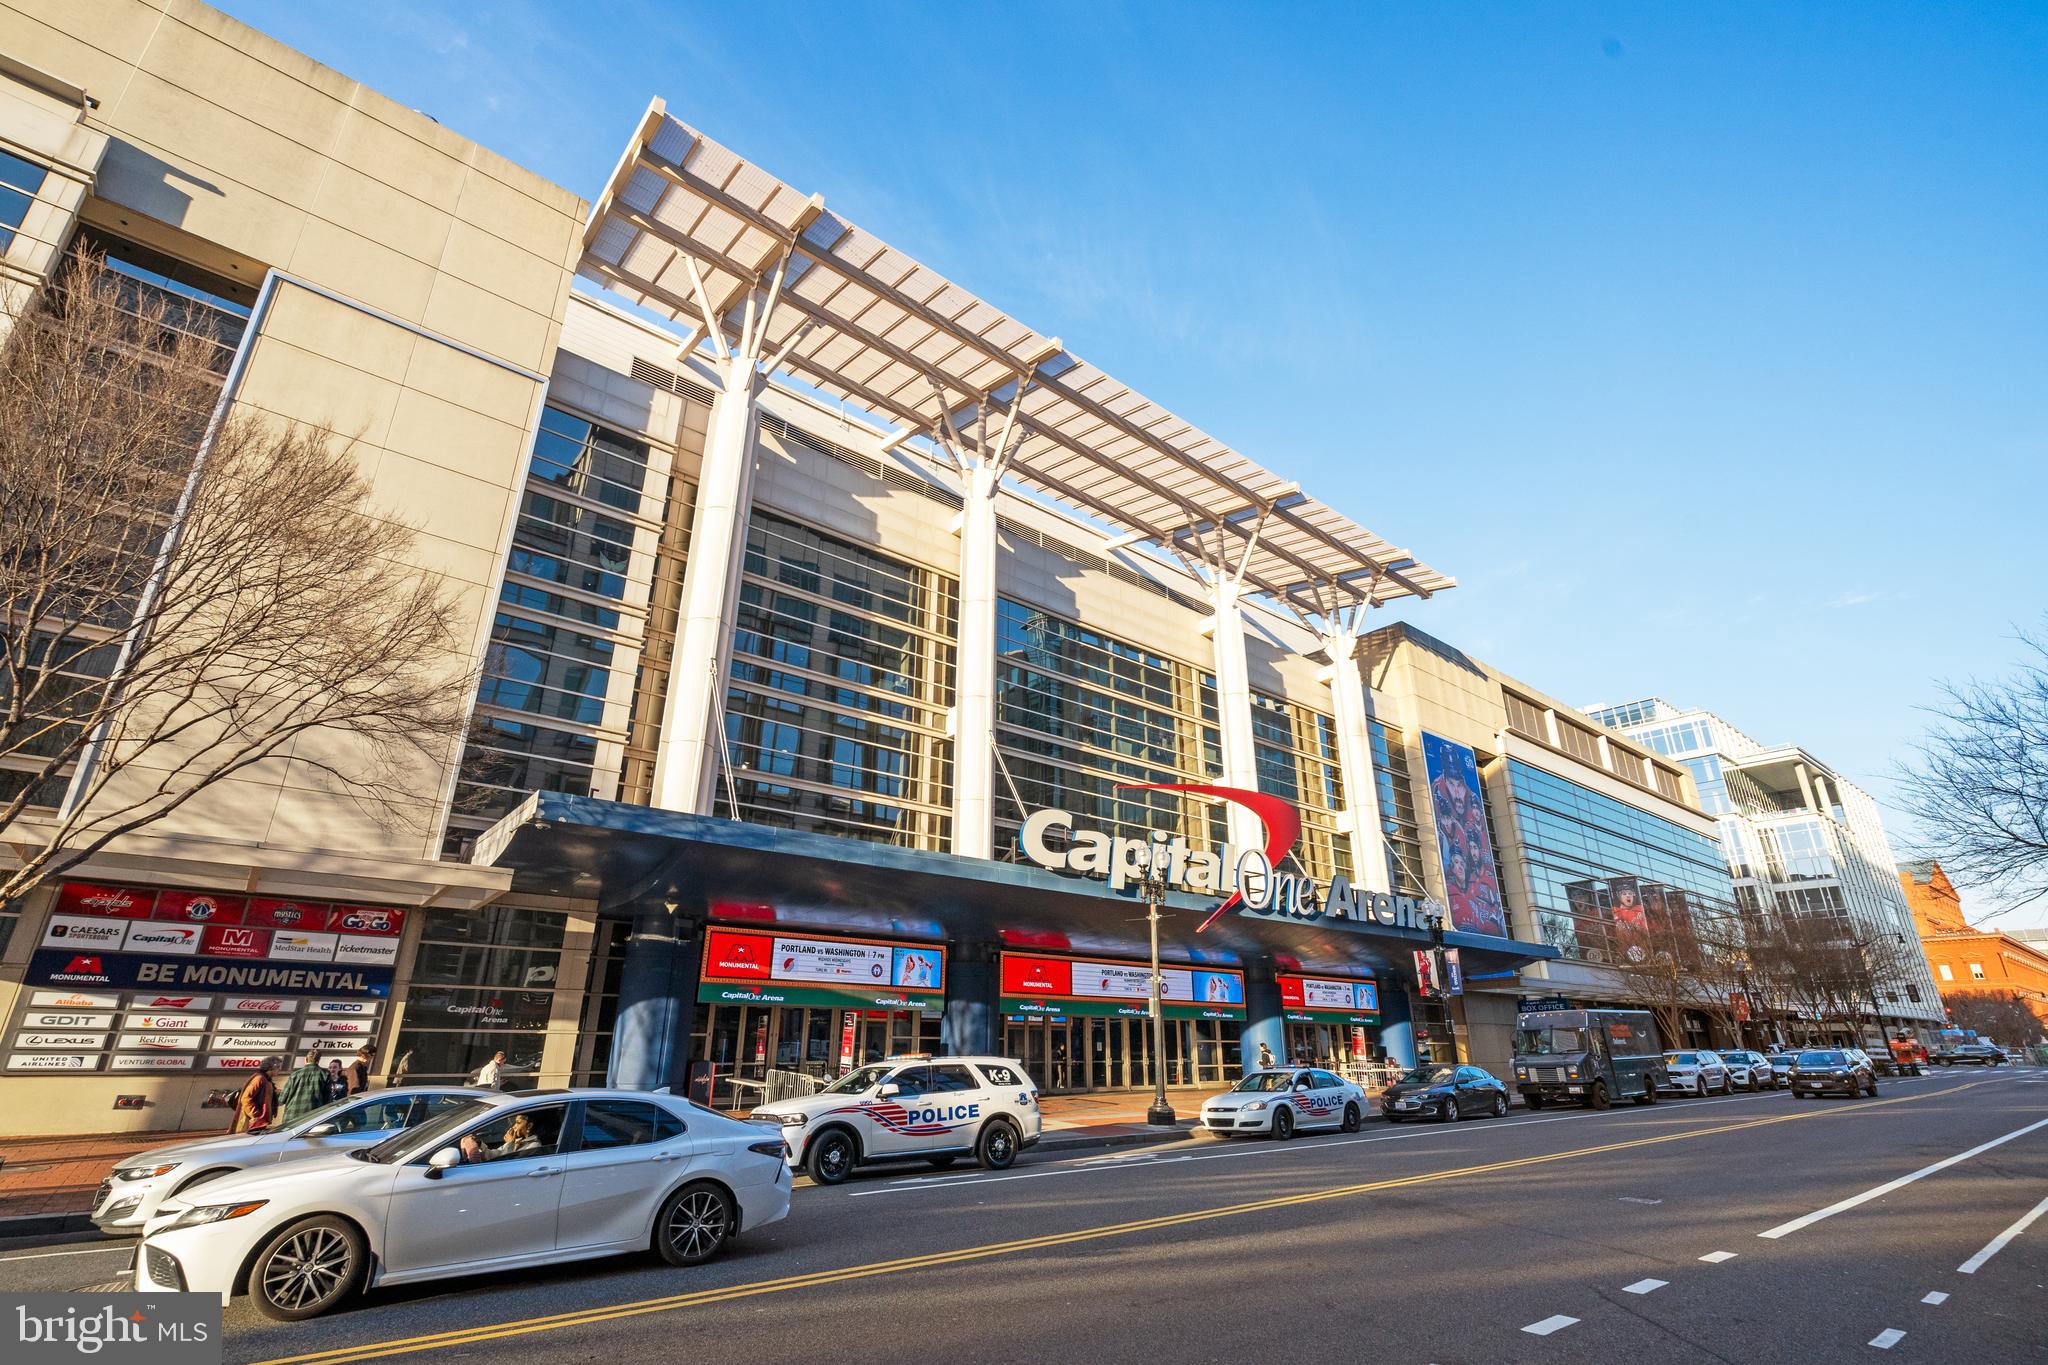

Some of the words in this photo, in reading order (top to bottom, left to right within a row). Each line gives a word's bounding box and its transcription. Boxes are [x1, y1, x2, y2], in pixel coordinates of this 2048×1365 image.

[70, 925, 120, 936] CAESARS
[68, 933, 110, 941] SPORTSBOOK
[208, 945, 259, 953] MONUMENTAL
[273, 944, 305, 953] MedStar
[307, 945, 332, 954] Health
[339, 944, 394, 955] ticketmaster
[781, 944, 816, 954] PORTLAND
[825, 947, 866, 958] WASHINGTON
[872, 951, 876, 959] 7
[719, 961, 759, 970] MONUMENTAL
[50, 973, 110, 982] MONUMENTAL
[136, 962, 178, 984] BE
[183, 964, 369, 991] MONUMENTAL
[1023, 981, 1053, 989] MONUMENTAL
[761, 994, 784, 1002] Arena
[320, 1003, 363, 1012] GEICO
[1538, 1003, 1565, 1011] OFFICE
[40, 1016, 97, 1026] GDIT
[155, 1017, 188, 1028] Giant
[329, 1022, 358, 1031] leidos
[139, 1035, 156, 1044] Red
[157, 1036, 179, 1044] River
[233, 1039, 277, 1047] Robinhood
[220, 1057, 262, 1068] verizo
[988, 1069, 1011, 1081] K-9
[1310, 1095, 1343, 1108] POLICE
[908, 1104, 980, 1125] POLICE
